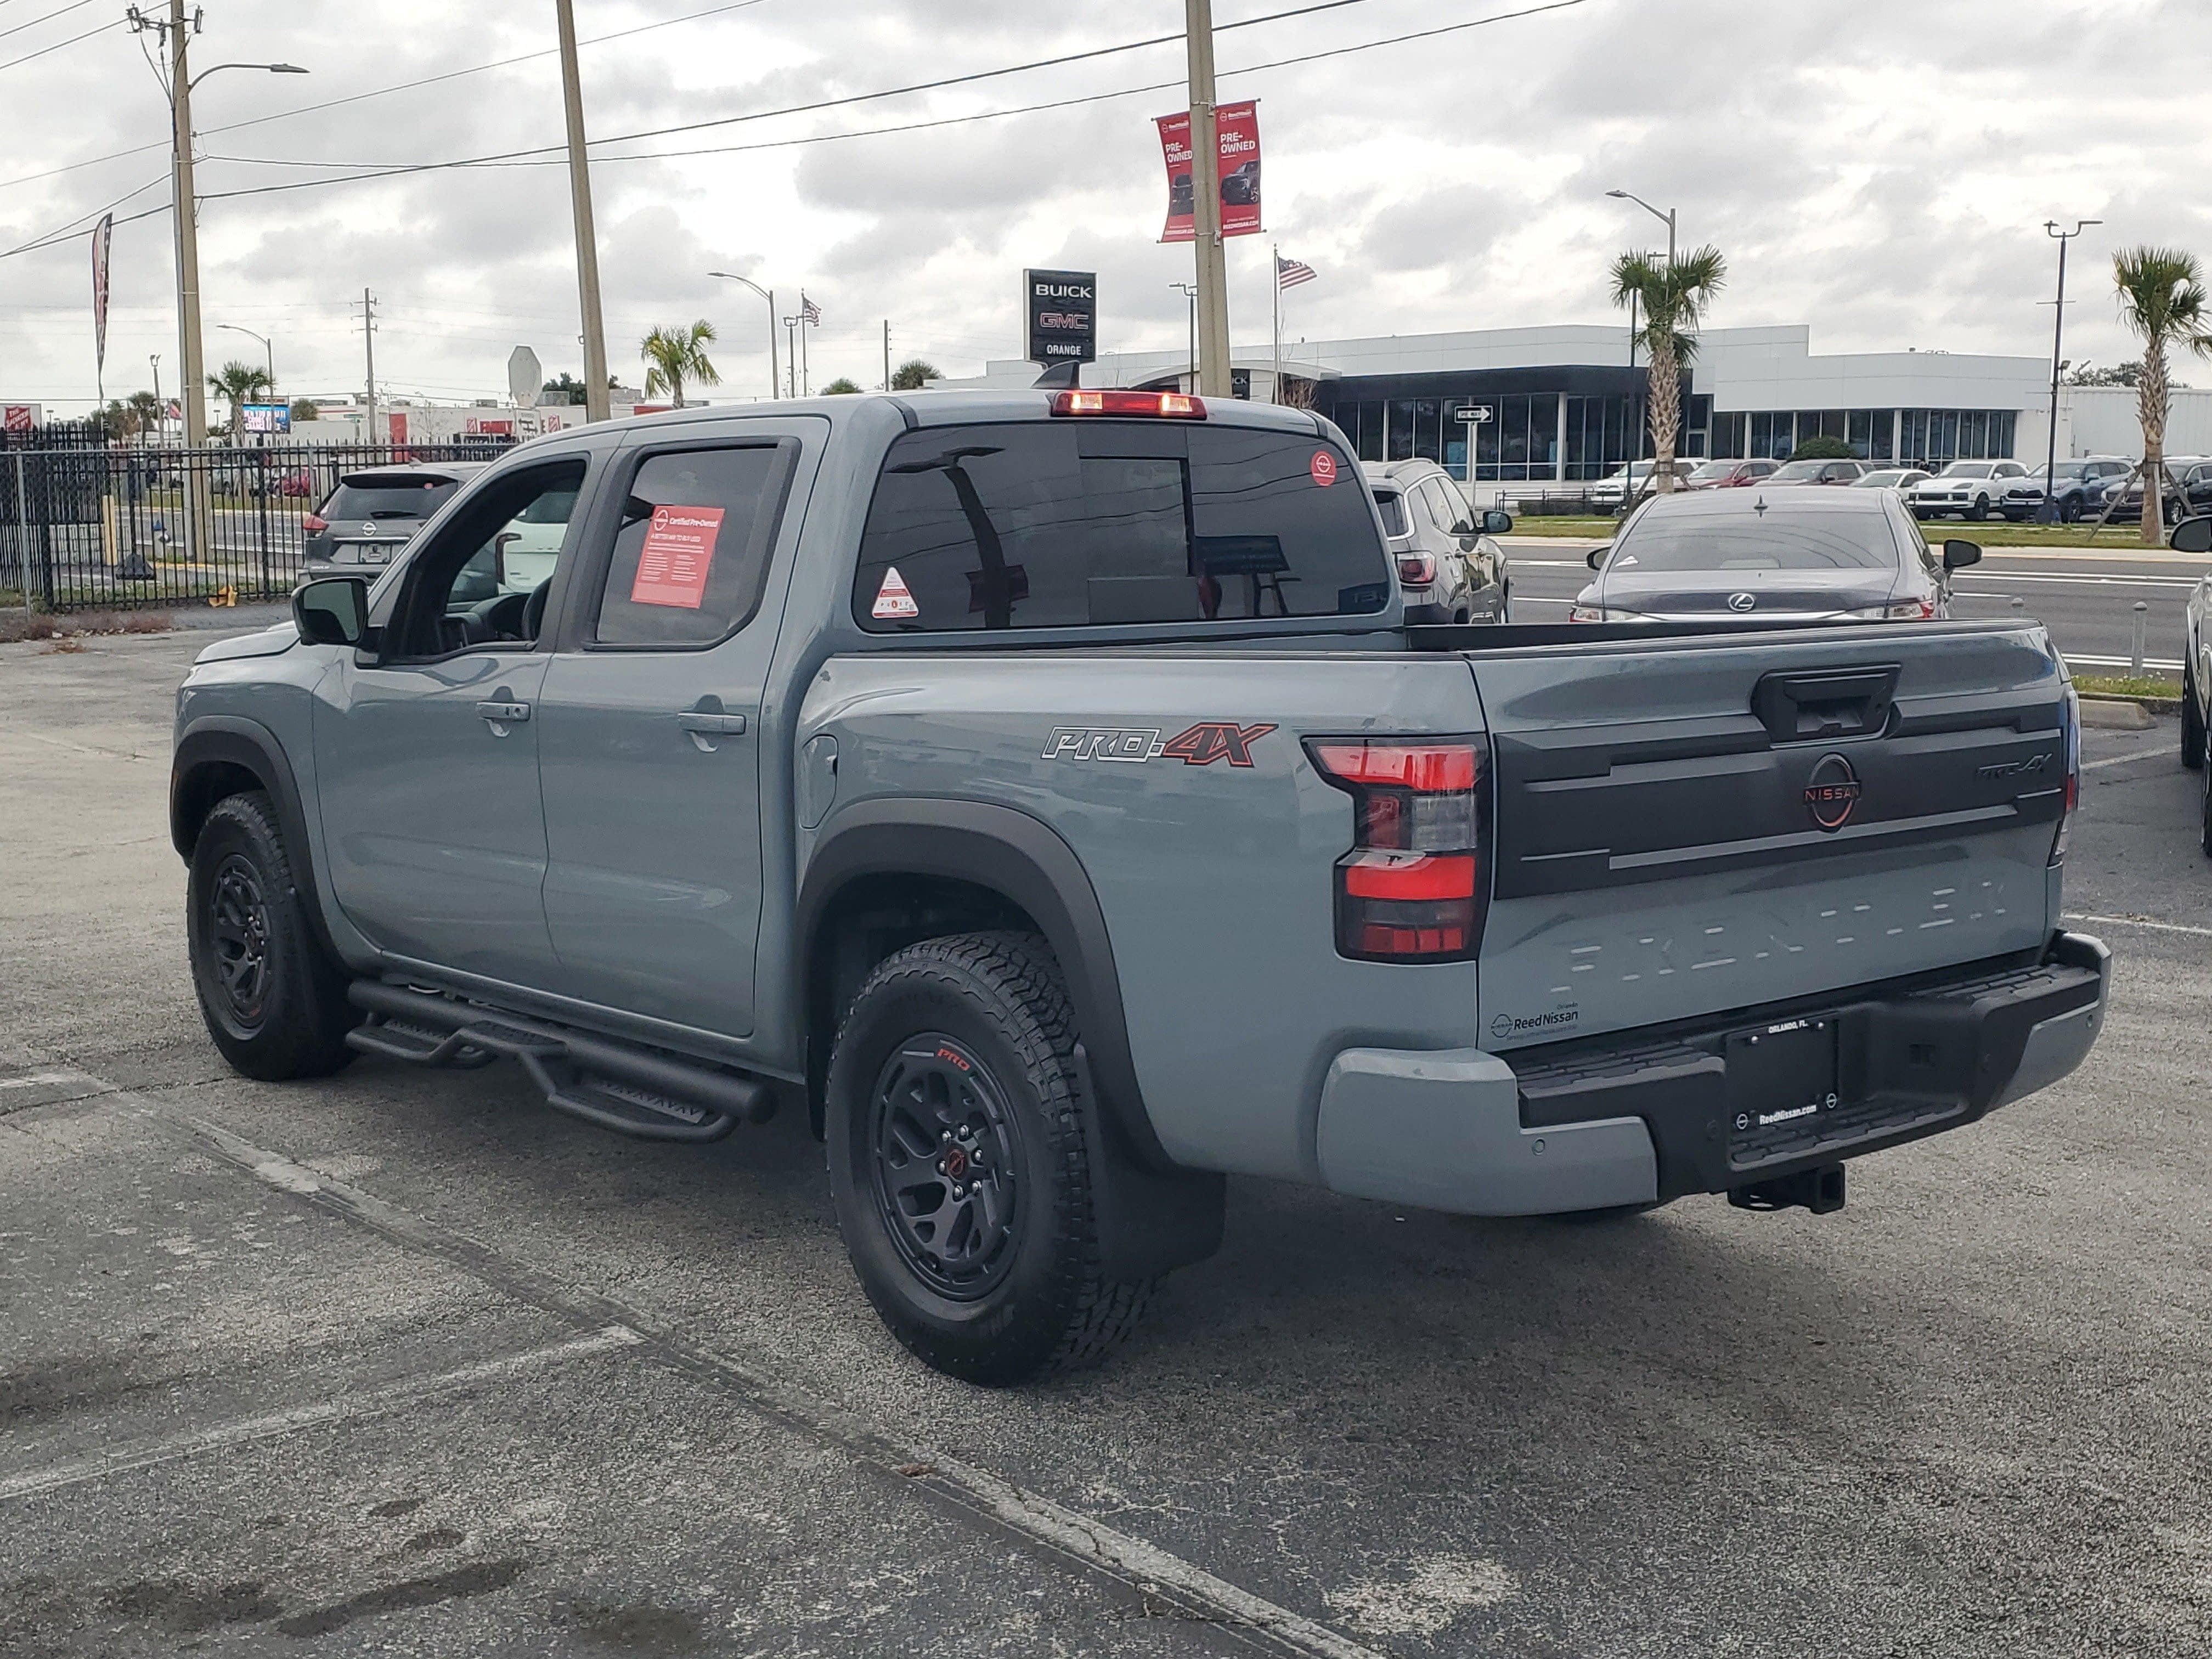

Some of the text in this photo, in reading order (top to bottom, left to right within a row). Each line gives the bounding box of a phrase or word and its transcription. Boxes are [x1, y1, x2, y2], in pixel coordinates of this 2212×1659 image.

[1220, 132, 1243, 144] PRE-
[1165, 142, 1183, 154] PRE-
[1220, 140, 1256, 154] OWNED
[1167, 150, 1193, 163] OWNED
[1036, 284, 1093, 298] BUICK
[1040, 313, 1089, 330] GMC
[1047, 345, 1081, 356] ORANGE
[1041, 721, 1279, 768] PRO-4X
[1805, 786, 1859, 801] NISSAN
[1768, 1022, 1798, 1034] ORLANDO,
[937, 1048, 970, 1071] PRO
[1759, 1104, 1817, 1125] ReedNissan.com
